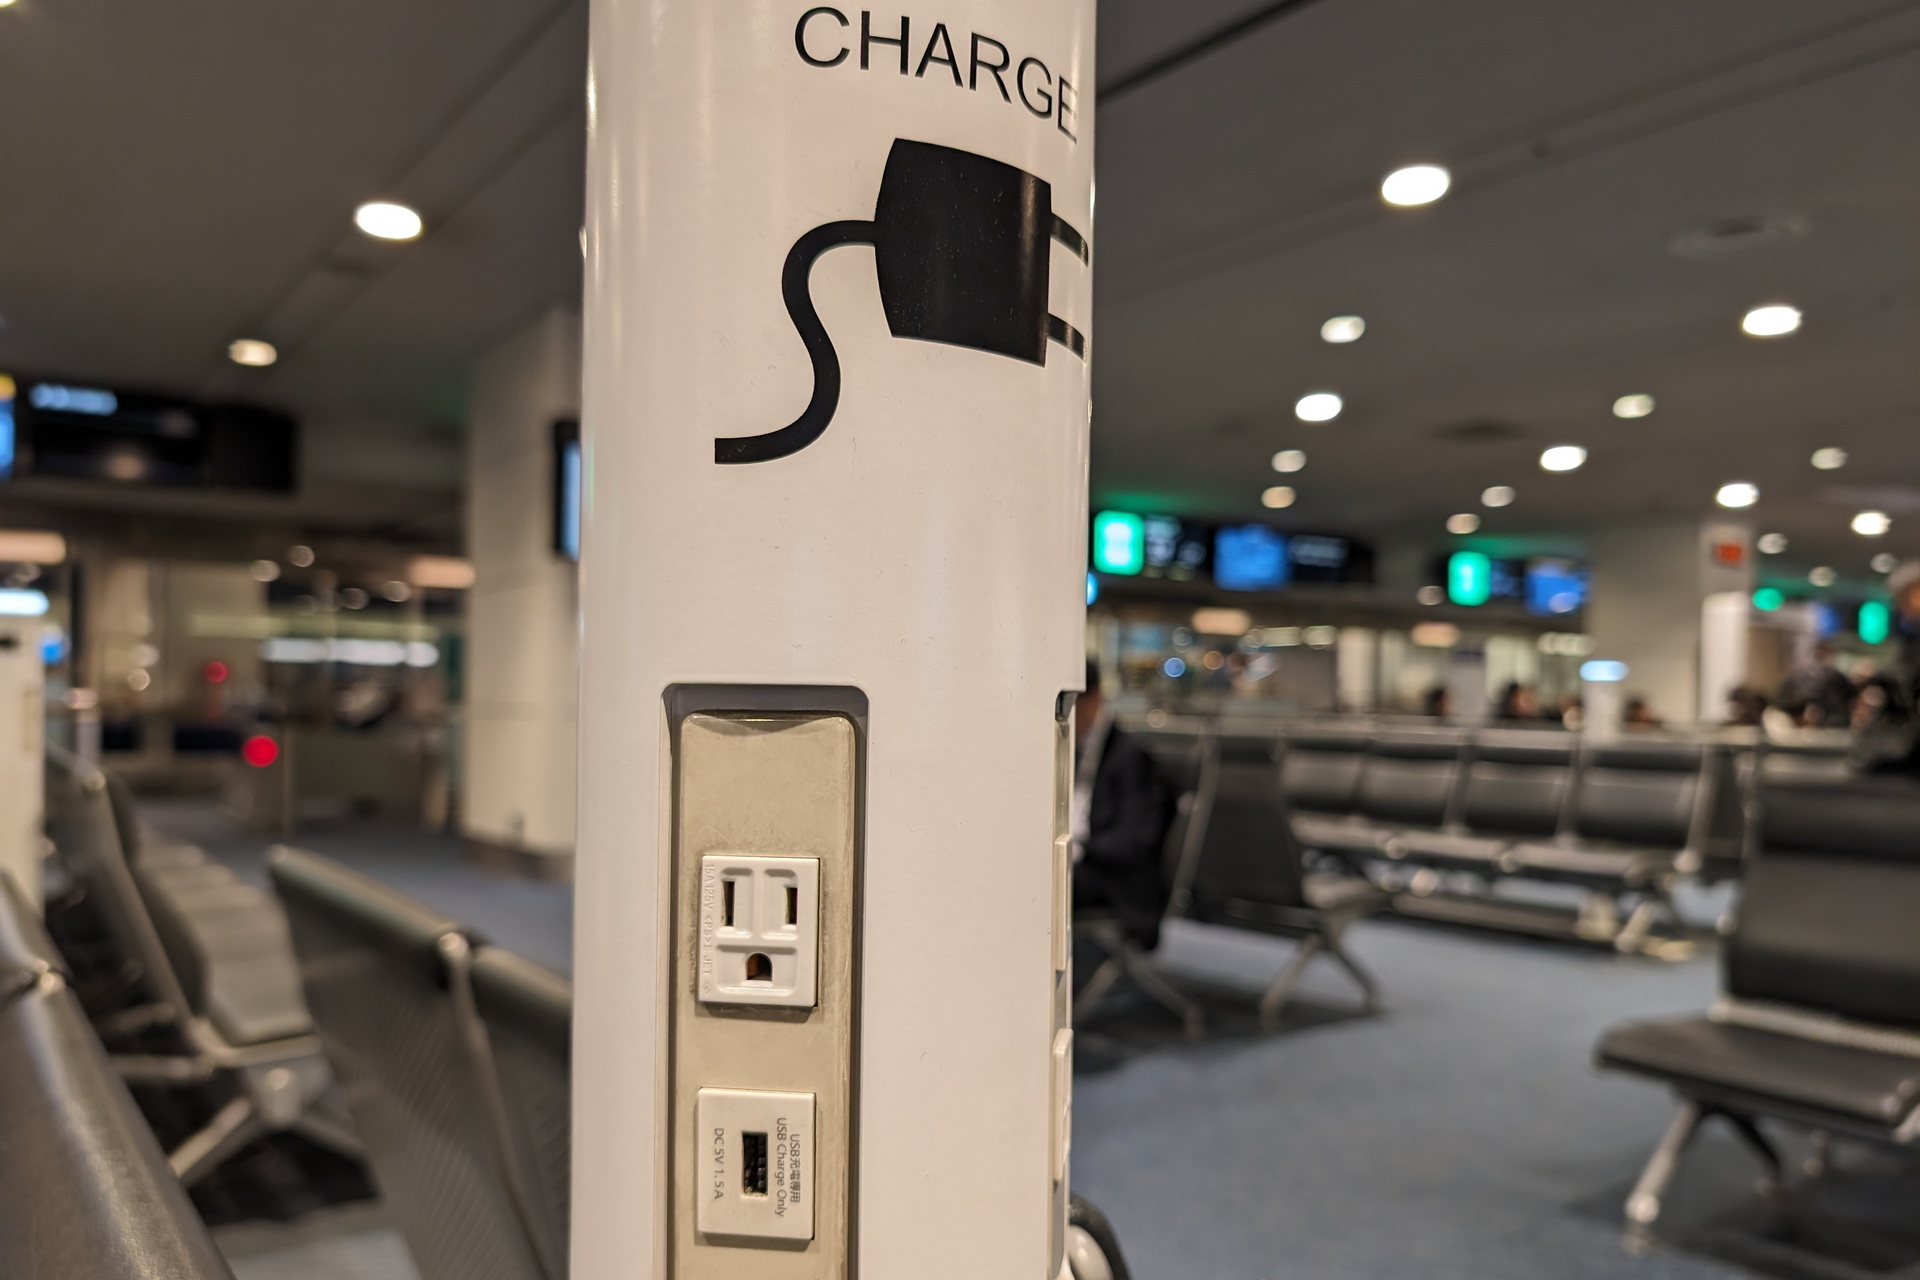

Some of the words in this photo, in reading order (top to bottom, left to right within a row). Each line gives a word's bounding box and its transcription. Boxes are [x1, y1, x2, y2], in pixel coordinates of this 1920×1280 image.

[794, 6, 1077, 145] CHARGE
[714, 1127, 725, 1145] DC
[776, 1117, 787, 1140] USB
[714, 1149, 725, 1165] 5V
[775, 1143, 787, 1186] Charge
[774, 1189, 787, 1217] Only
